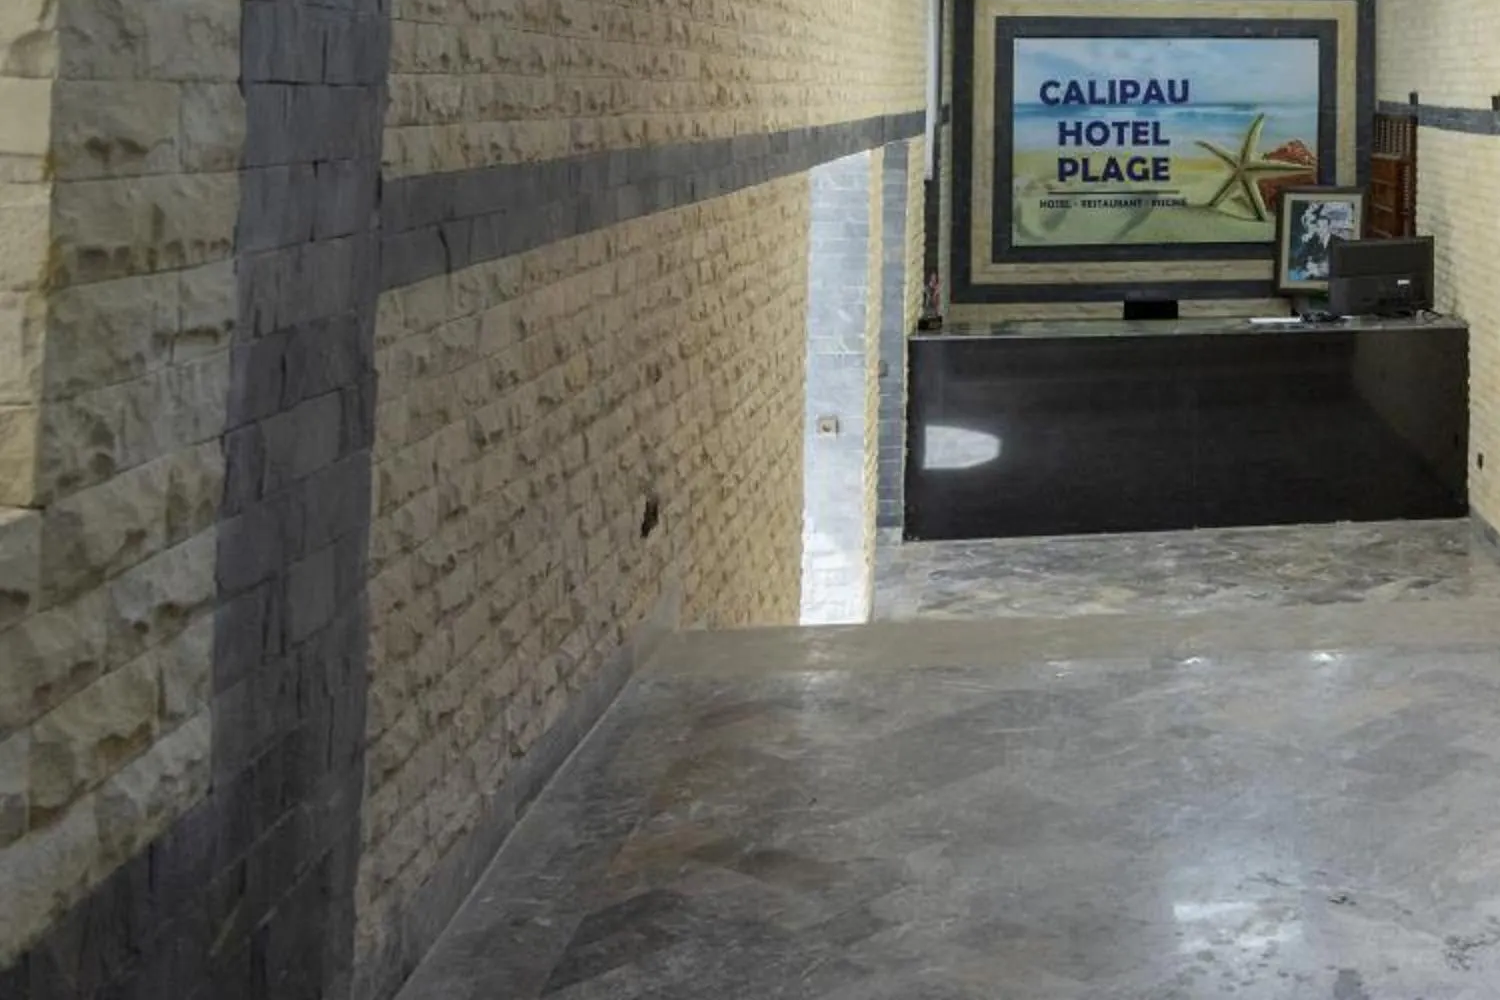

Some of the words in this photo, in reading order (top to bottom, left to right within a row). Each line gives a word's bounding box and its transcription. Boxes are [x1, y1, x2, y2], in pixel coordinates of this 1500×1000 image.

[1039, 79, 1190, 106] CALIPAU
[1057, 121, 1170, 146] HOTEL
[1057, 157, 1170, 182] PLAGE
